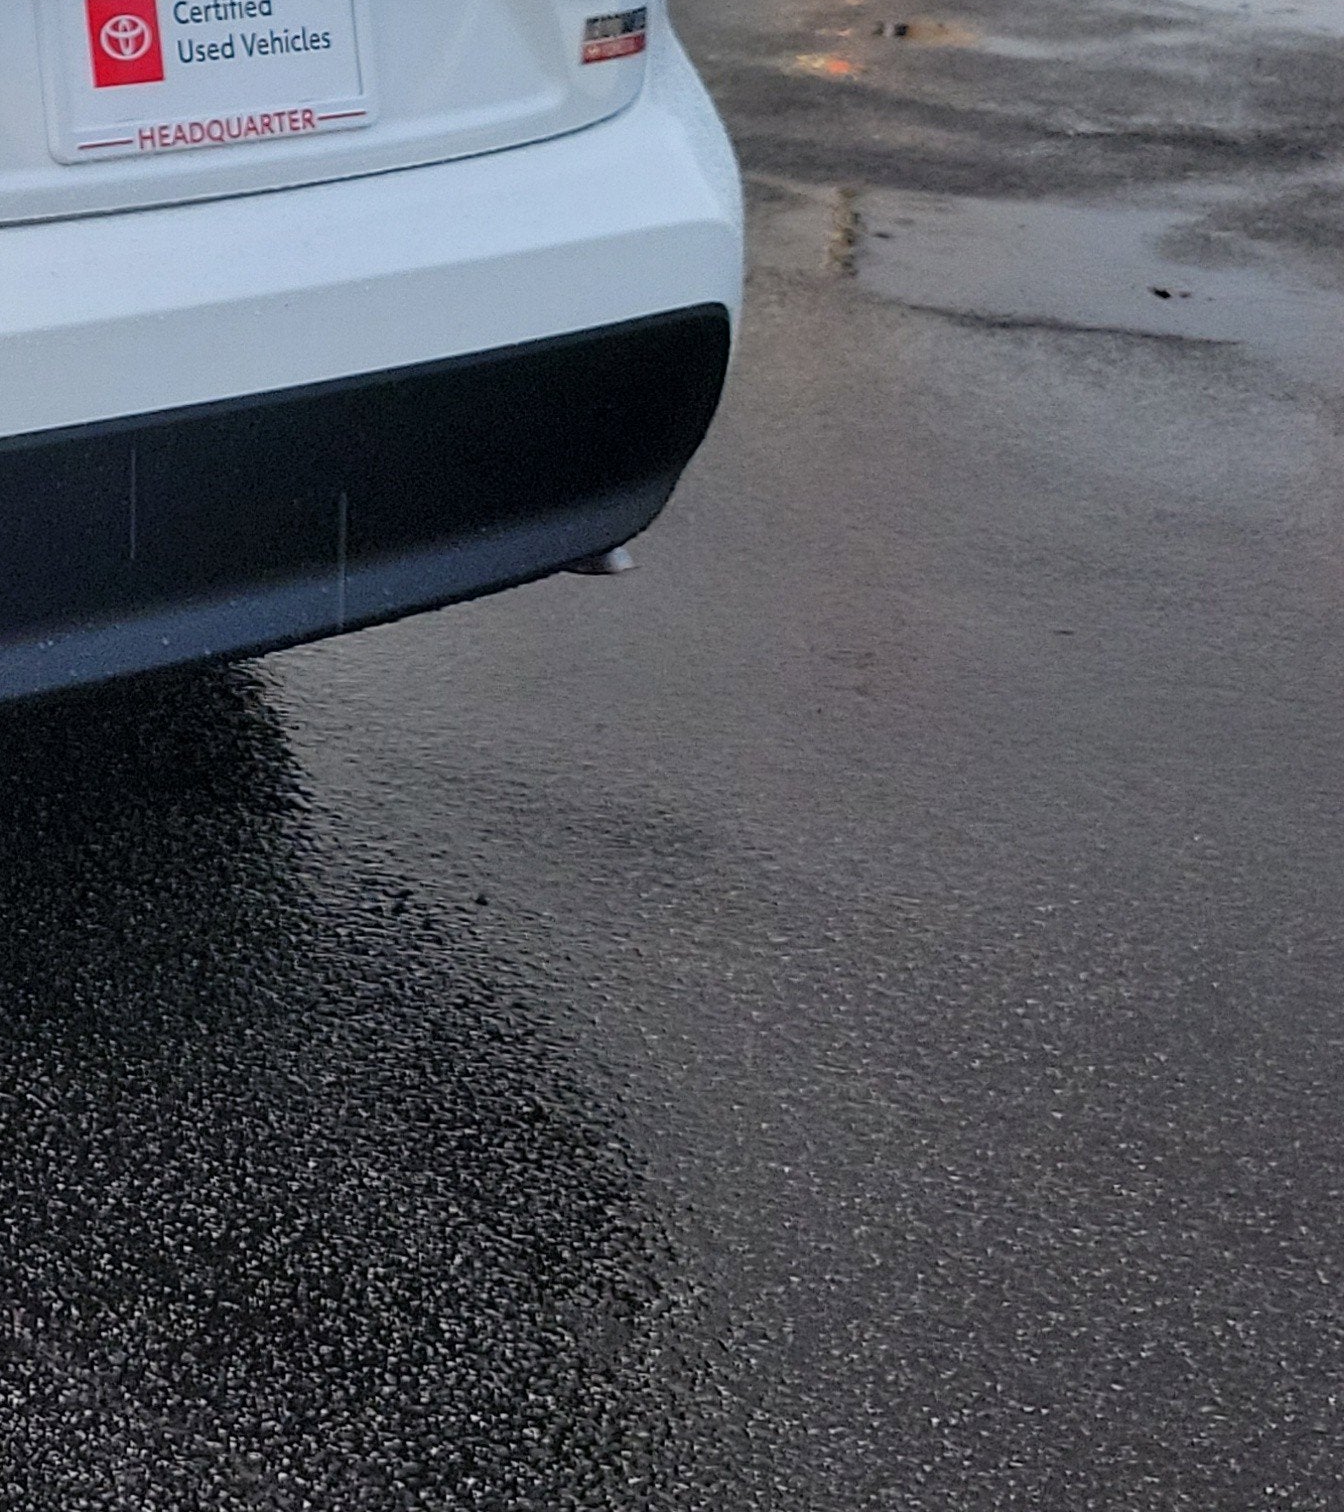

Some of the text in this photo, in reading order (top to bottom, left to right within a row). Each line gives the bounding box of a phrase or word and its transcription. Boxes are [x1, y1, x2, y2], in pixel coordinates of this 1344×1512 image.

[177, 27, 332, 63] Used Vehicles
[138, 108, 316, 150] HEADQUARTER
